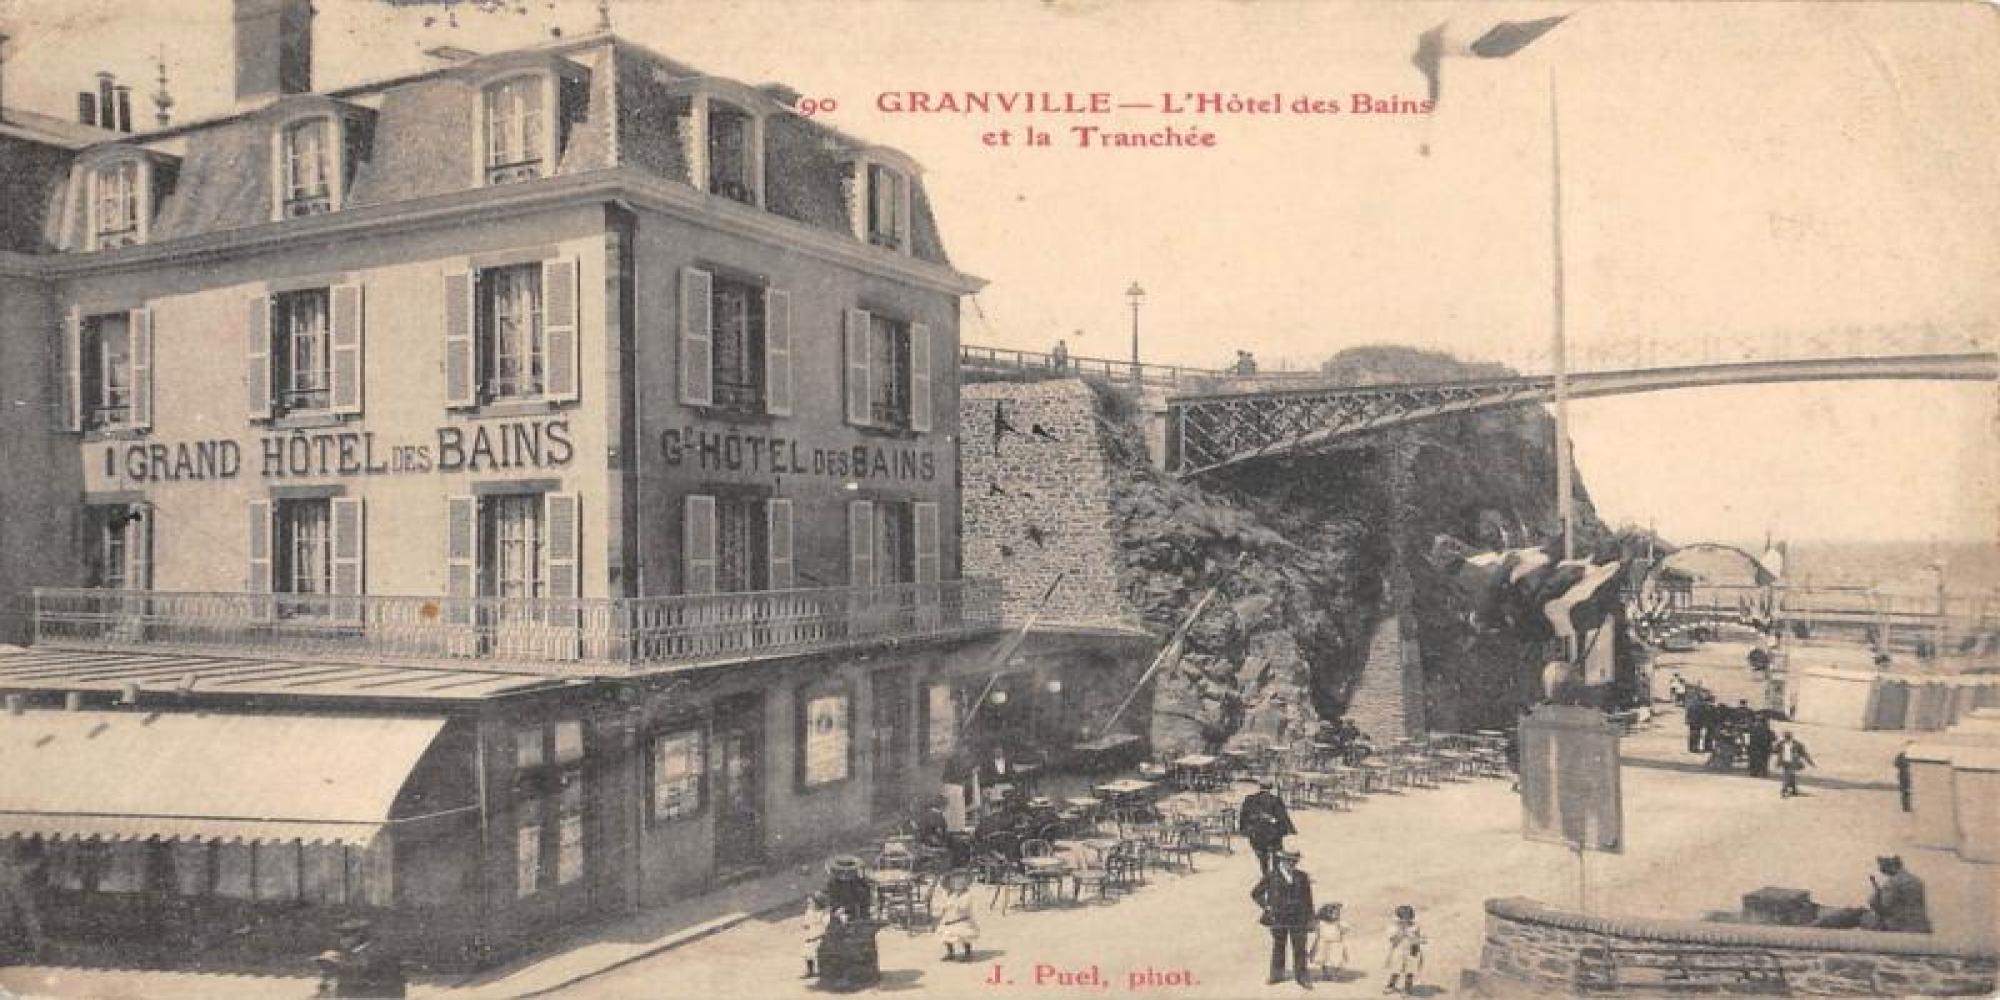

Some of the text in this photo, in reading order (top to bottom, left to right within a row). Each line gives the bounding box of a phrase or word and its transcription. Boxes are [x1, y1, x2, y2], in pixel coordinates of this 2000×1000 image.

[125, 420, 575, 482] GRAND HÔTEL DES BAINS
[699, 424, 808, 475] HÔTEL
[812, 448, 849, 477] DES
[851, 446, 937, 481] BAINS
